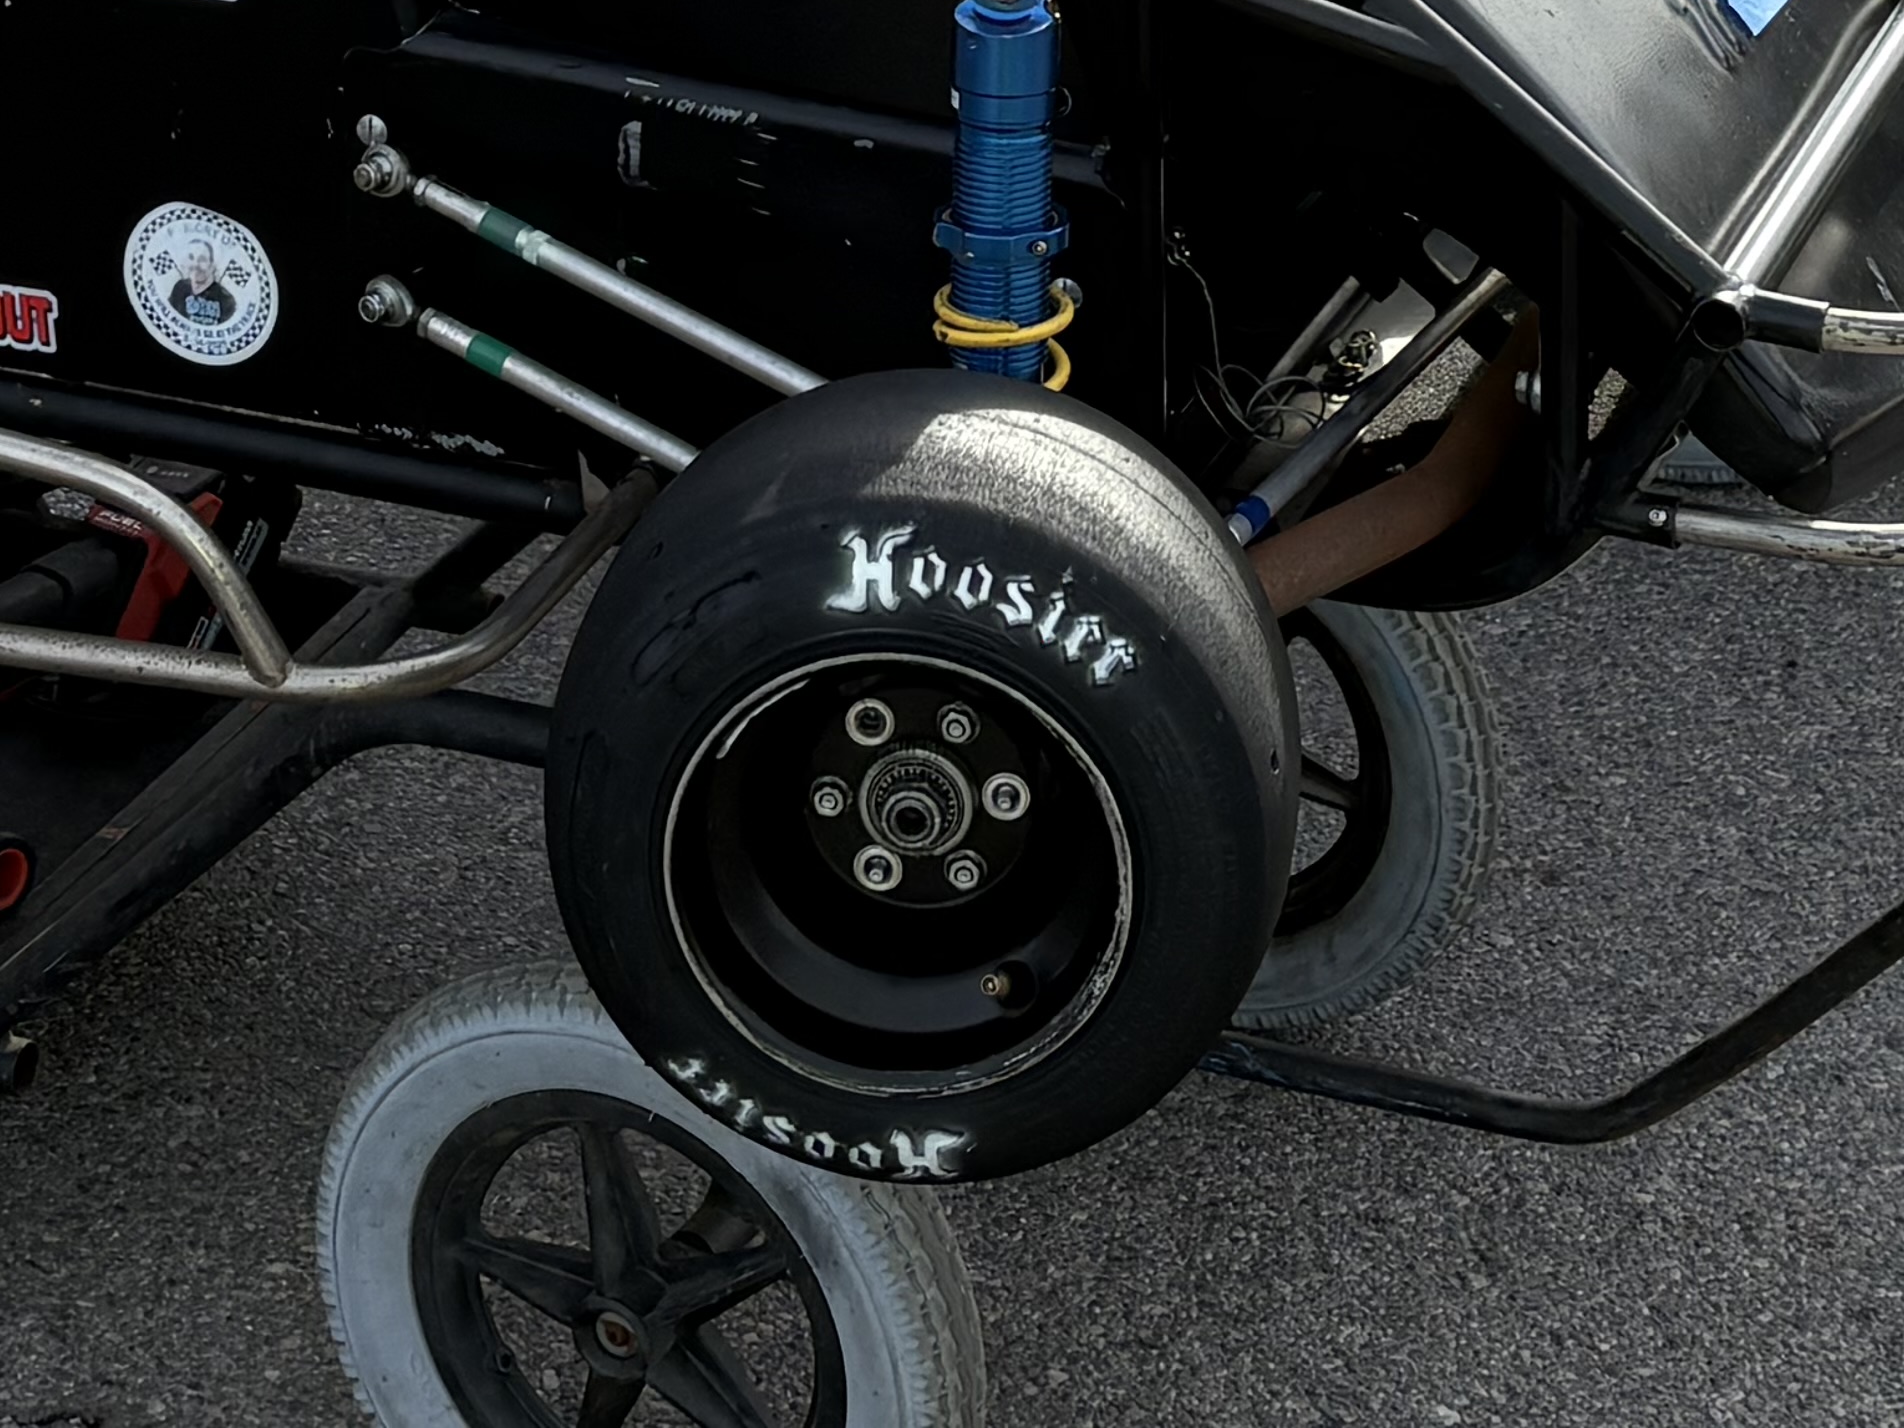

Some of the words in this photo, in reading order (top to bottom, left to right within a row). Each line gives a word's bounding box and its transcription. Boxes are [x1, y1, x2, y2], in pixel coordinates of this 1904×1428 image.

[99, 509, 144, 532] FUEL
[822, 525, 1142, 687] Hoosier
[659, 1054, 966, 1180] Hoosier
